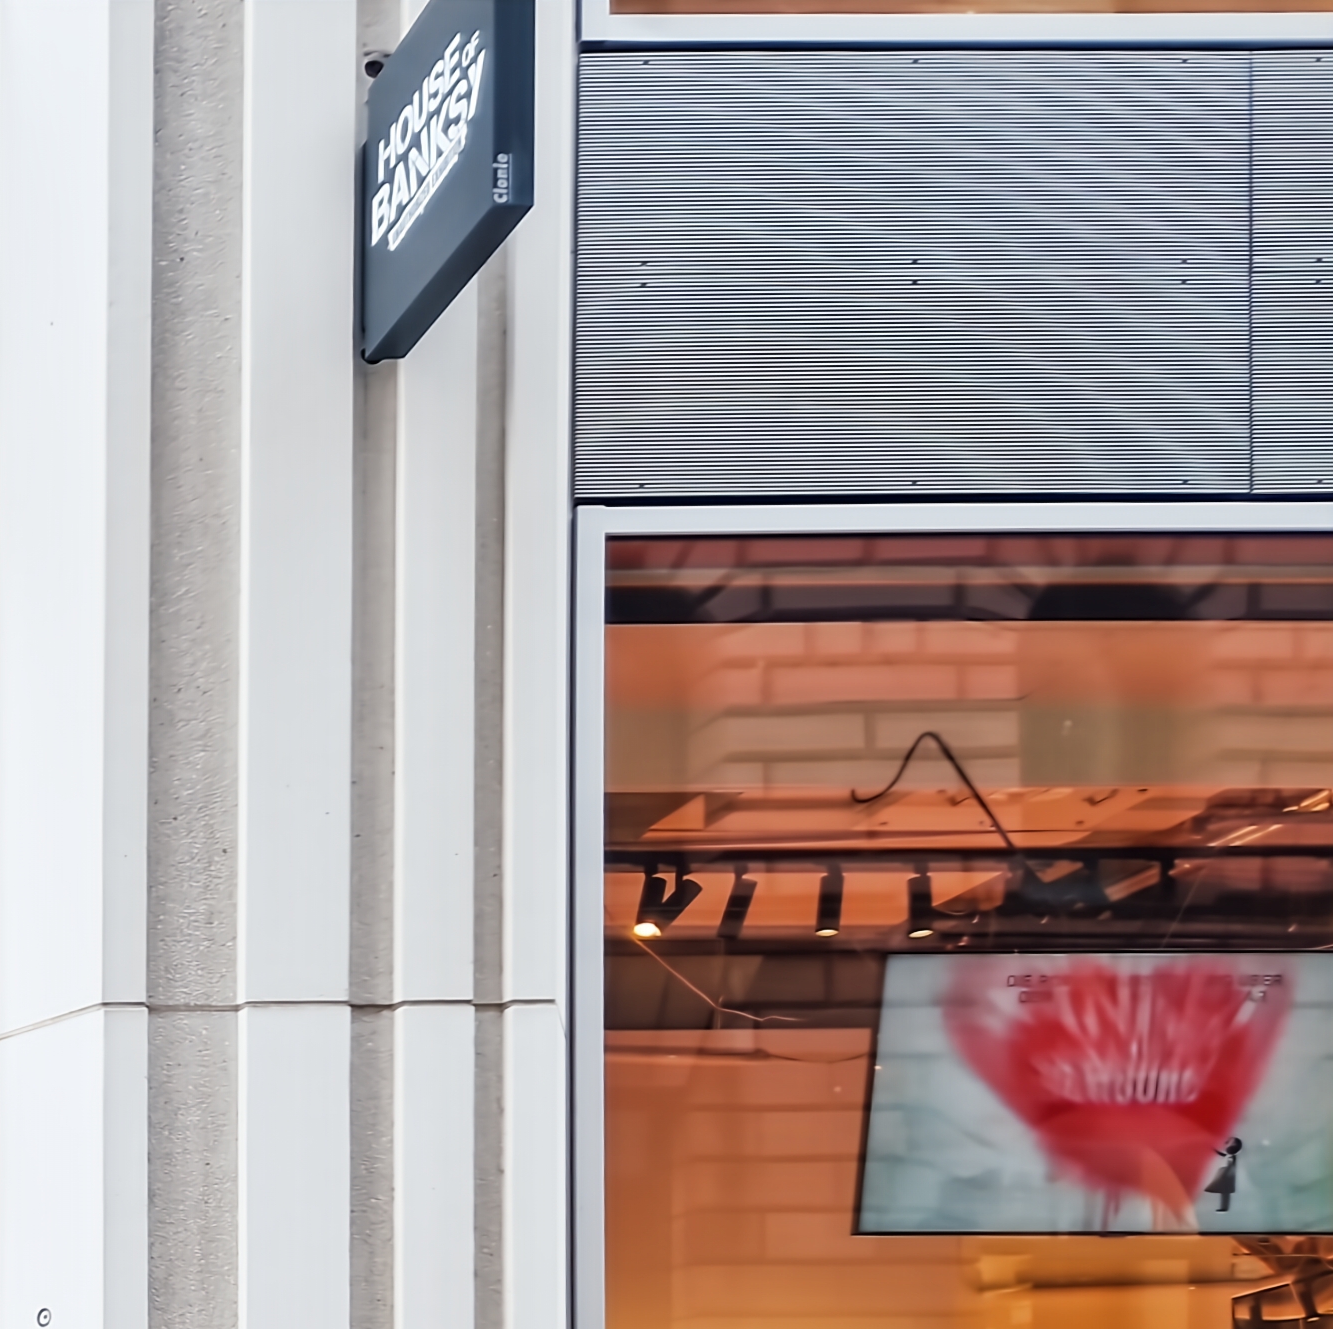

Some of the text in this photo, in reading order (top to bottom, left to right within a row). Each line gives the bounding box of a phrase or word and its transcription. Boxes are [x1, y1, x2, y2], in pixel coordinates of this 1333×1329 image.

[371, 49, 486, 247] BANKSY
[378, 32, 461, 184] HOUSE
[462, 30, 480, 67] OF
